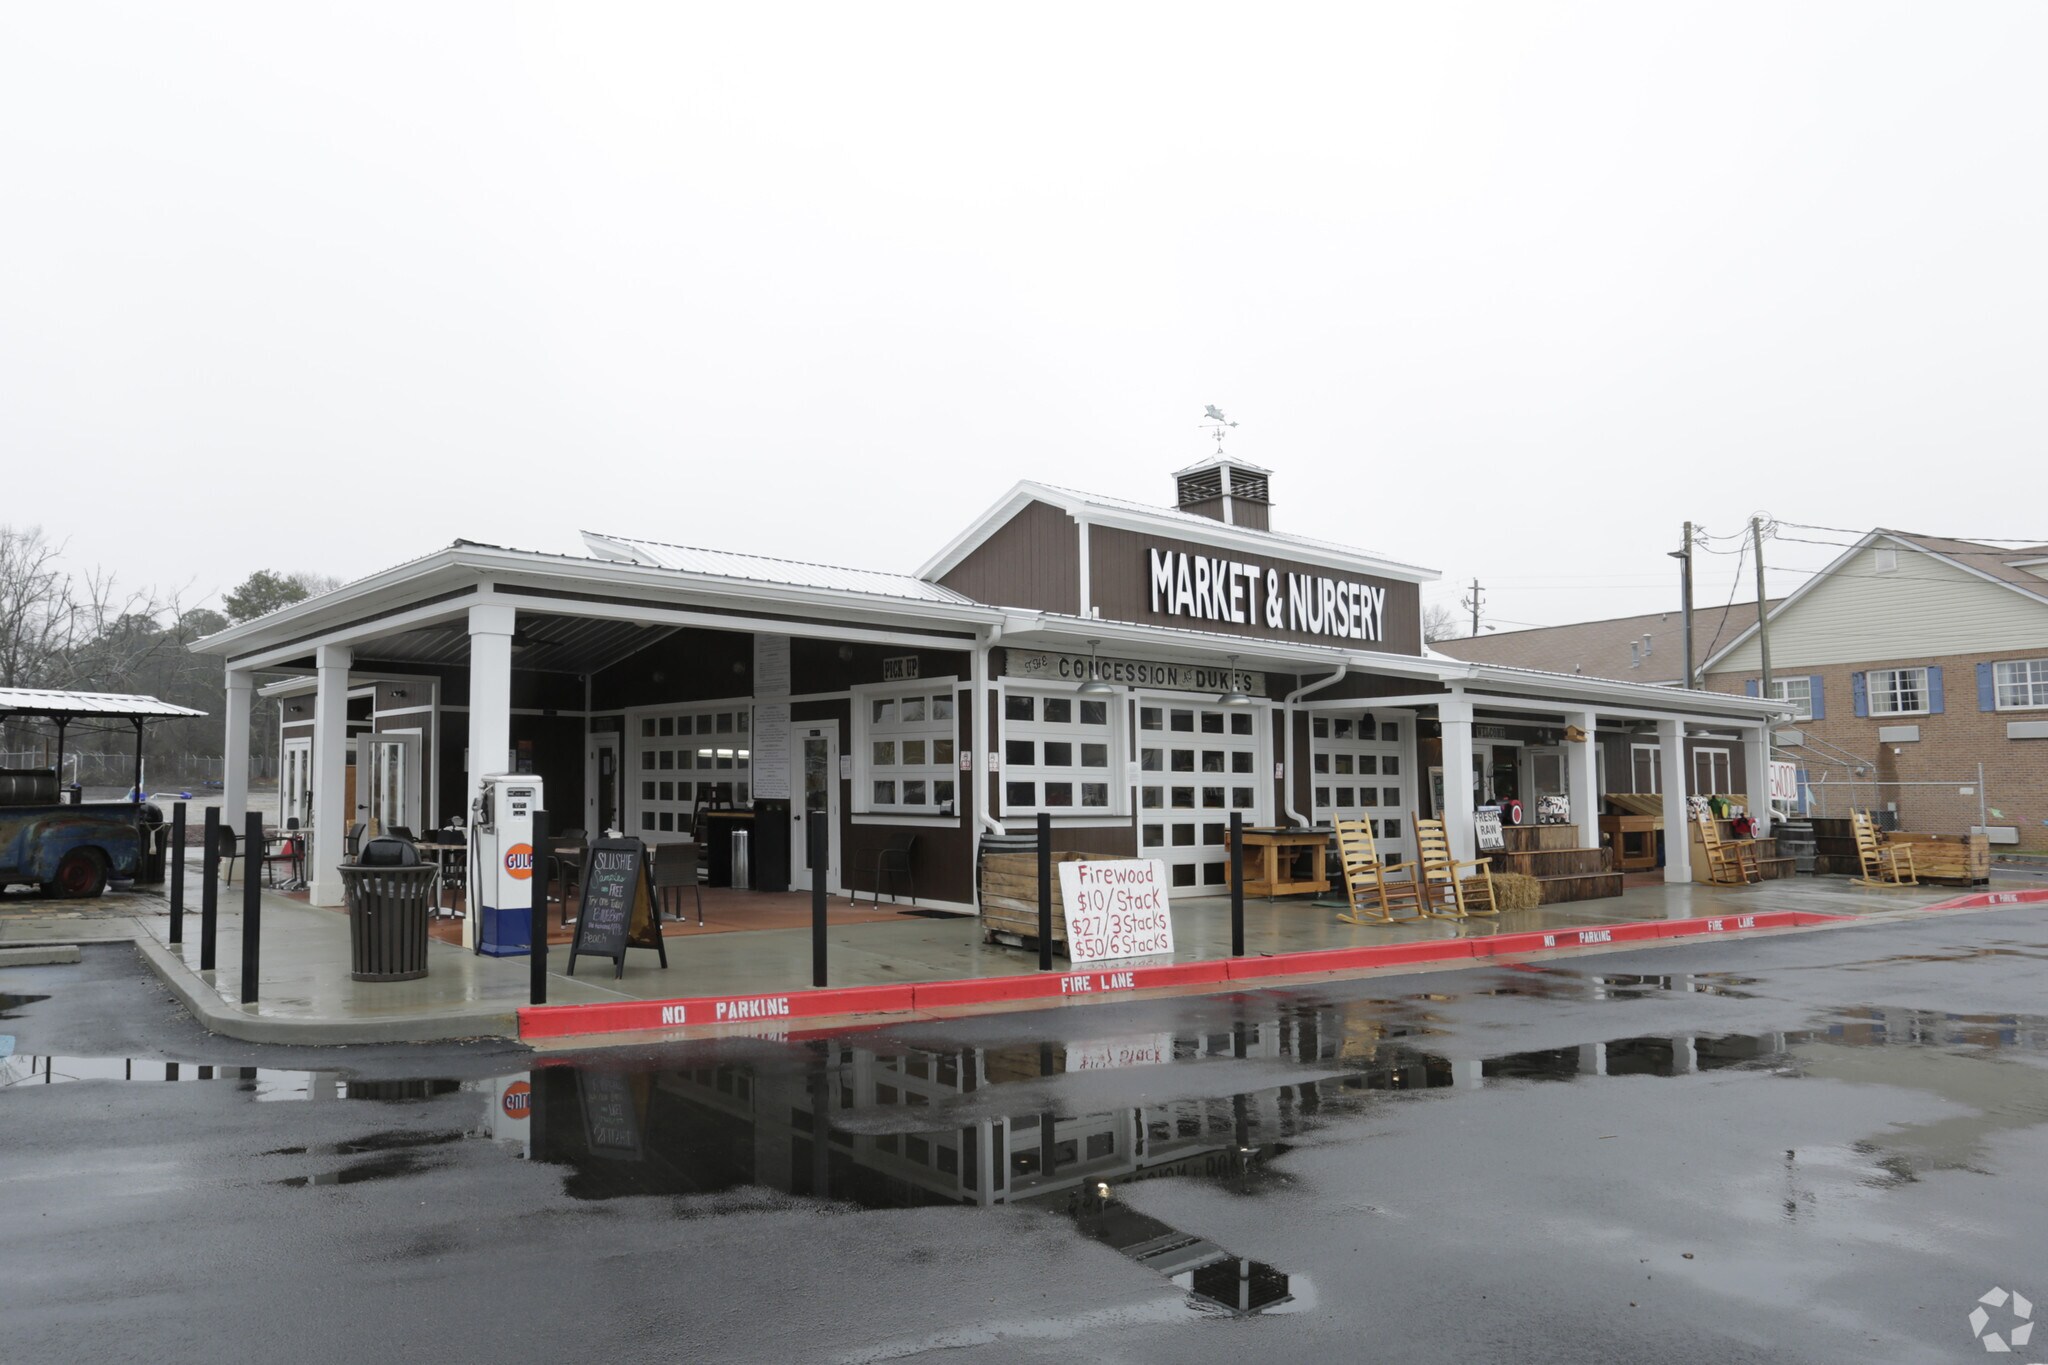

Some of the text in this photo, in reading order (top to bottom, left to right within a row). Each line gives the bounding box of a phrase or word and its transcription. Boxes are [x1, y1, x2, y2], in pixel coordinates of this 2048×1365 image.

[1150, 547, 1385, 642] MARKET & NURSERY
[885, 658, 918, 679] PICK UP
[1024, 655, 1048, 673] THE
[1058, 657, 1178, 686] CONCESSION
[1474, 812, 1498, 822] FRESH
[1480, 825, 1497, 835] RAW
[1482, 838, 1500, 848] MILK
[595, 852, 634, 871] SLUSHIE
[1078, 862, 1153, 885] Firewood
[609, 884, 624, 898] FREE
[588, 895, 599, 907] Try
[1123, 911, 1167, 934] Stacks
[1708, 917, 1755, 931] FIRE LANE
[583, 931, 607, 946] Peach
[1122, 932, 1168, 954] Stacks
[1544, 930, 1611, 947] NO PARKING
[1061, 972, 1135, 993] FIRE LANE
[662, 998, 789, 1024] NO PARKING
